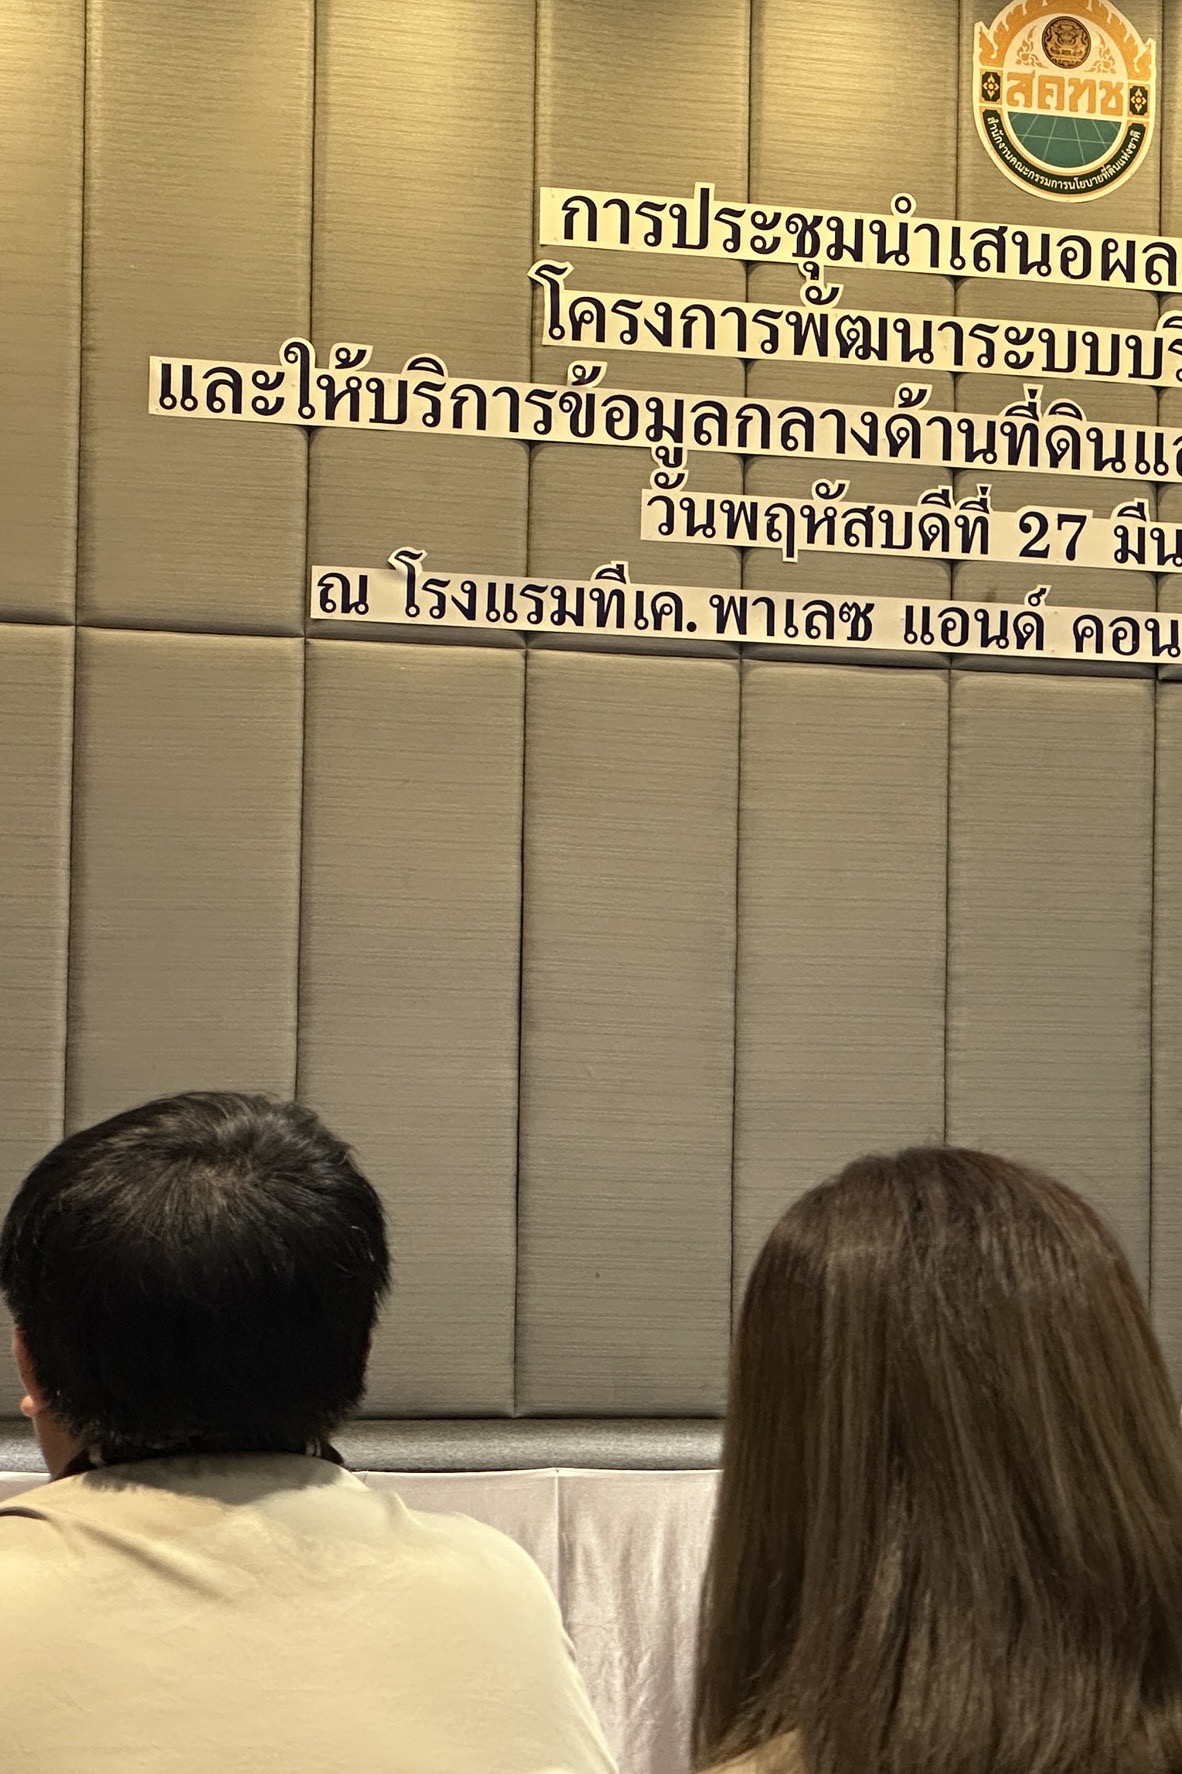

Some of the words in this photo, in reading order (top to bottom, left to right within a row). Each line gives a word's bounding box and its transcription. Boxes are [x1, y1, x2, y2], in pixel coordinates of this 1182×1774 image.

[1006, 70, 1125, 116] สคทช
[987, 117, 1141, 190] สำนักงานคณะกรรมการนโยบายที่ดินแห่งชาติ
[646, 472, 990, 560] วันพฤหัสบดีที่
[1018, 511, 1088, 560] 27
[317, 568, 369, 615] ณ
[903, 588, 1046, 652] แอนด์
